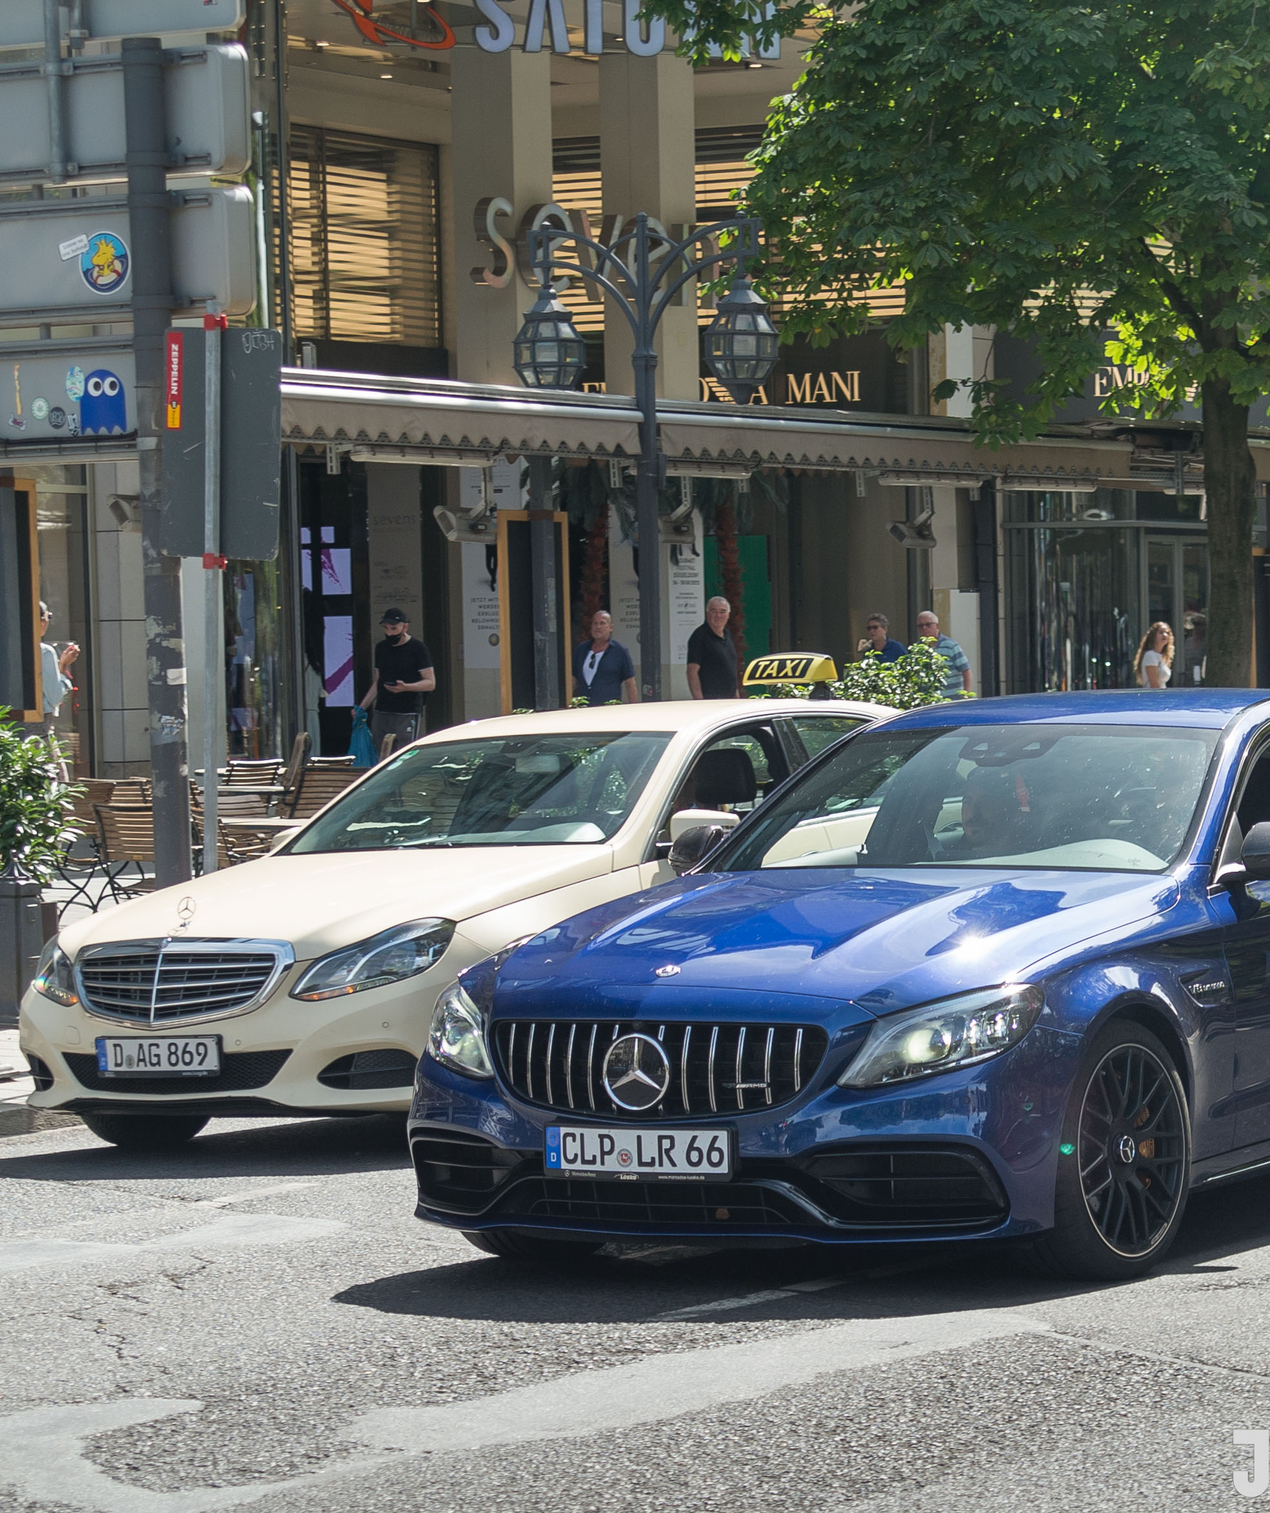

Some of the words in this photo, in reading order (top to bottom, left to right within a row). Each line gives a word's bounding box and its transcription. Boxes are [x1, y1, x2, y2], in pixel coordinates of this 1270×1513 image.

[171, 343, 179, 395] ZEPPELIN
[754, 659, 808, 678] TAXI
[113, 1043, 124, 1068] D
[136, 1043, 161, 1068] AG
[167, 1042, 208, 1068] 869
[550, 1152, 557, 1162] D
[562, 1132, 615, 1166] CLP
[637, 1134, 677, 1168] LR
[685, 1135, 724, 1168] 66
